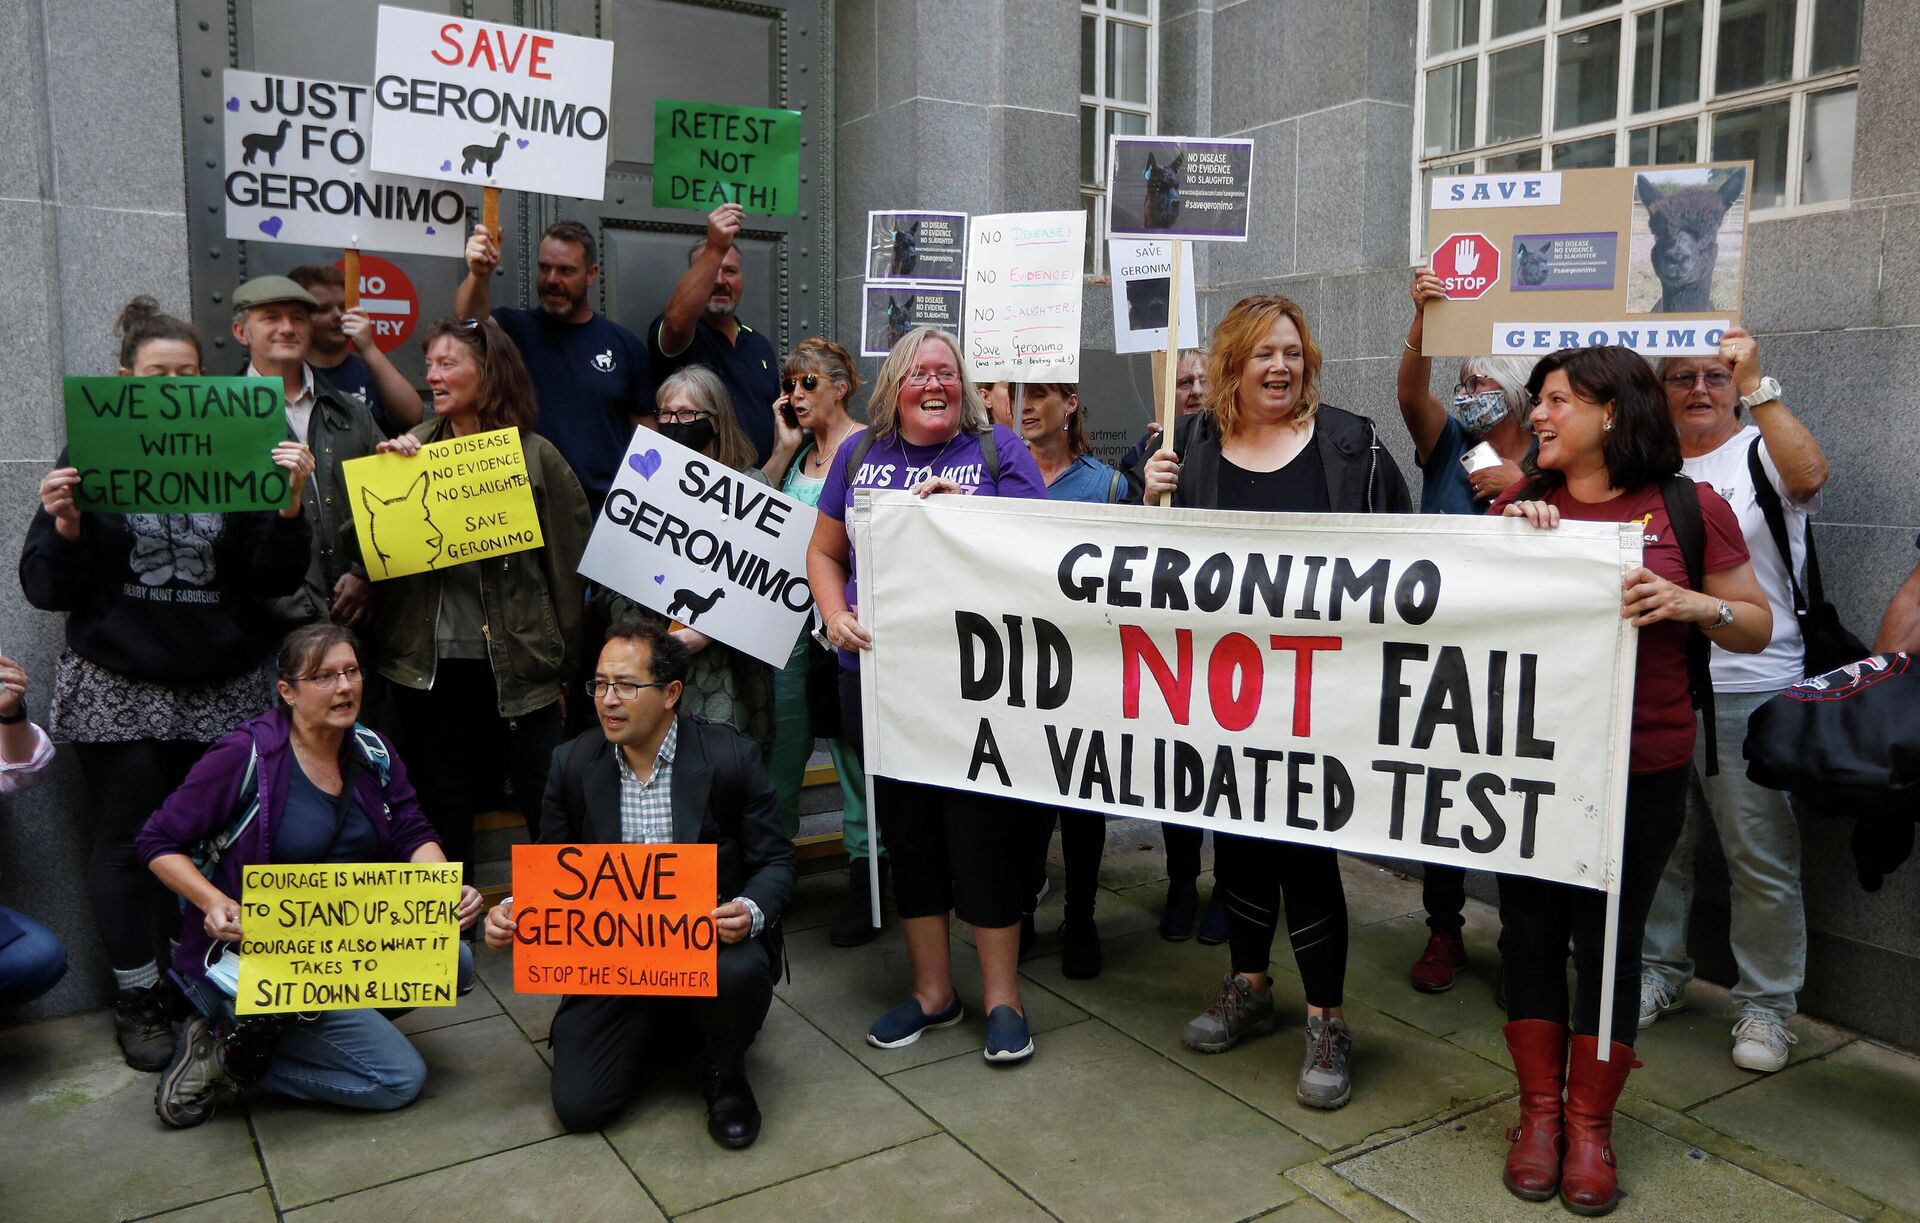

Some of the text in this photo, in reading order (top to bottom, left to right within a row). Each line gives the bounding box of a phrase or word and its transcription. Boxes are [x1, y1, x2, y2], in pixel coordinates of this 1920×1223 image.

[431, 23, 554, 80] SAVE
[250, 77, 367, 122] JUST
[375, 75, 608, 141] GERONIMO
[672, 109, 776, 144] RETEST
[302, 124, 365, 165] FO
[700, 149, 756, 174] NOT
[1187, 163, 1231, 174] NO EVIDENCE
[1188, 153, 1227, 163] NO DISEASE
[1187, 175, 1234, 185] NO SLAUGHTER
[1450, 180, 1541, 201] SAVE
[226, 171, 465, 225] GERONIMO
[671, 176, 776, 211] DEATH!
[1185, 200, 1233, 211] #savegeronimo
[929, 229, 951, 237] EVIDENCE
[980, 231, 1001, 244] NO
[1136, 247, 1162, 257] SAVE
[977, 270, 996, 283] NO
[1121, 263, 1171, 276] GERONIM
[1445, 277, 1487, 291] STOP
[925, 296, 944, 304] DISEASE
[974, 302, 1075, 321] NO SLAUGHTER!
[973, 336, 1063, 357] Save Geronimo
[1505, 327, 1726, 349] GERONIMO
[1029, 357, 1051, 367] testing
[81, 384, 277, 420] WE STAND
[140, 433, 212, 456] WITH
[1090, 429, 1127, 440] artment
[429, 433, 511, 461] NO DISEASE
[1092, 444, 1129, 455] nvironm
[433, 452, 521, 481] NO EVIDENCE
[852, 463, 982, 487] AYS TO WIN
[80, 469, 288, 505] GERONIMO
[437, 488, 458, 502] NO
[678, 460, 792, 538] SAVE
[465, 511, 508, 532] SAVE
[447, 530, 534, 559] GERONIMO
[605, 488, 814, 612] GERONIMO
[150, 588, 174, 602] HUNT
[1058, 543, 1441, 625] GERONIMO
[955, 610, 1555, 760] DID NOT FAIL
[967, 717, 1555, 859] A VALIDATED TEST
[246, 870, 458, 889] COURAGE IS WHAT IT TAKES
[553, 847, 678, 901] SAVE
[244, 903, 270, 917] TO
[278, 899, 359, 928] STAND
[365, 901, 388, 925] UP
[403, 900, 461, 926] SPEAK
[515, 907, 714, 950] GERONIMO
[242, 936, 450, 955] COURAGE IS ALSO WHAT IT
[290, 959, 377, 975] TAKES TO
[528, 965, 709, 988] STOP THE SLAUGHTER
[255, 979, 450, 1007] SIT DOWN & LISTEN
